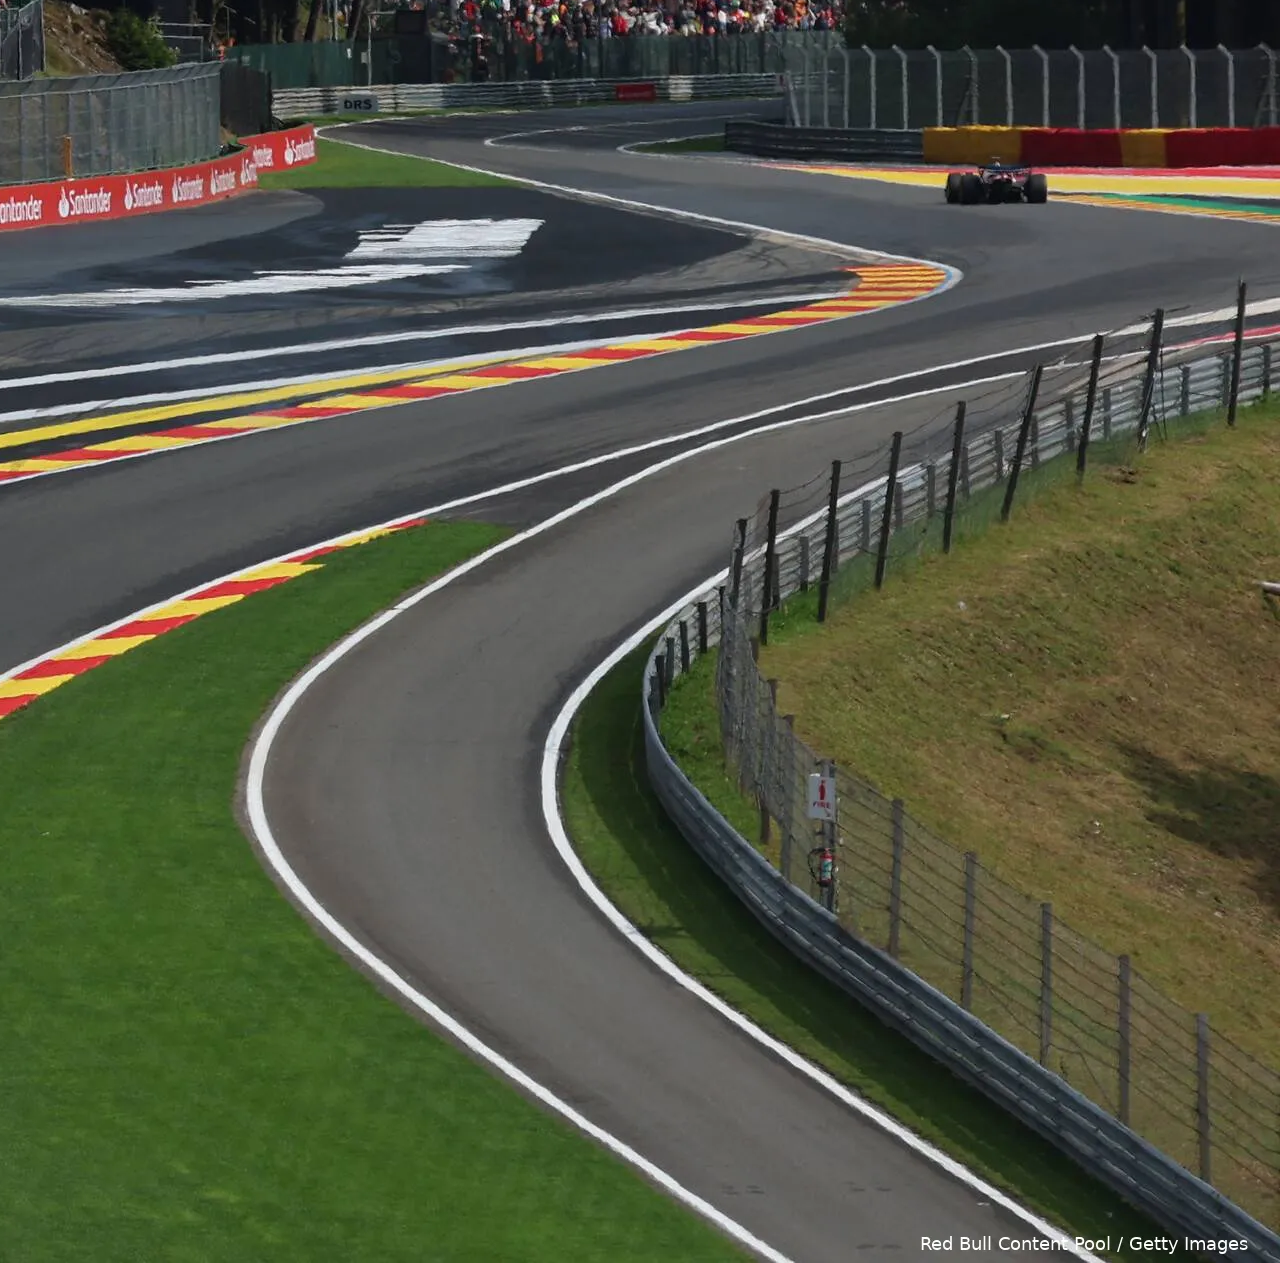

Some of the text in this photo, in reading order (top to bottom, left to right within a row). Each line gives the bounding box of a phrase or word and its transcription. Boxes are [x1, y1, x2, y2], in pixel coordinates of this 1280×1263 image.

[343, 98, 373, 111] DRS
[69, 186, 112, 216] Santander
[132, 180, 164, 209] Santander
